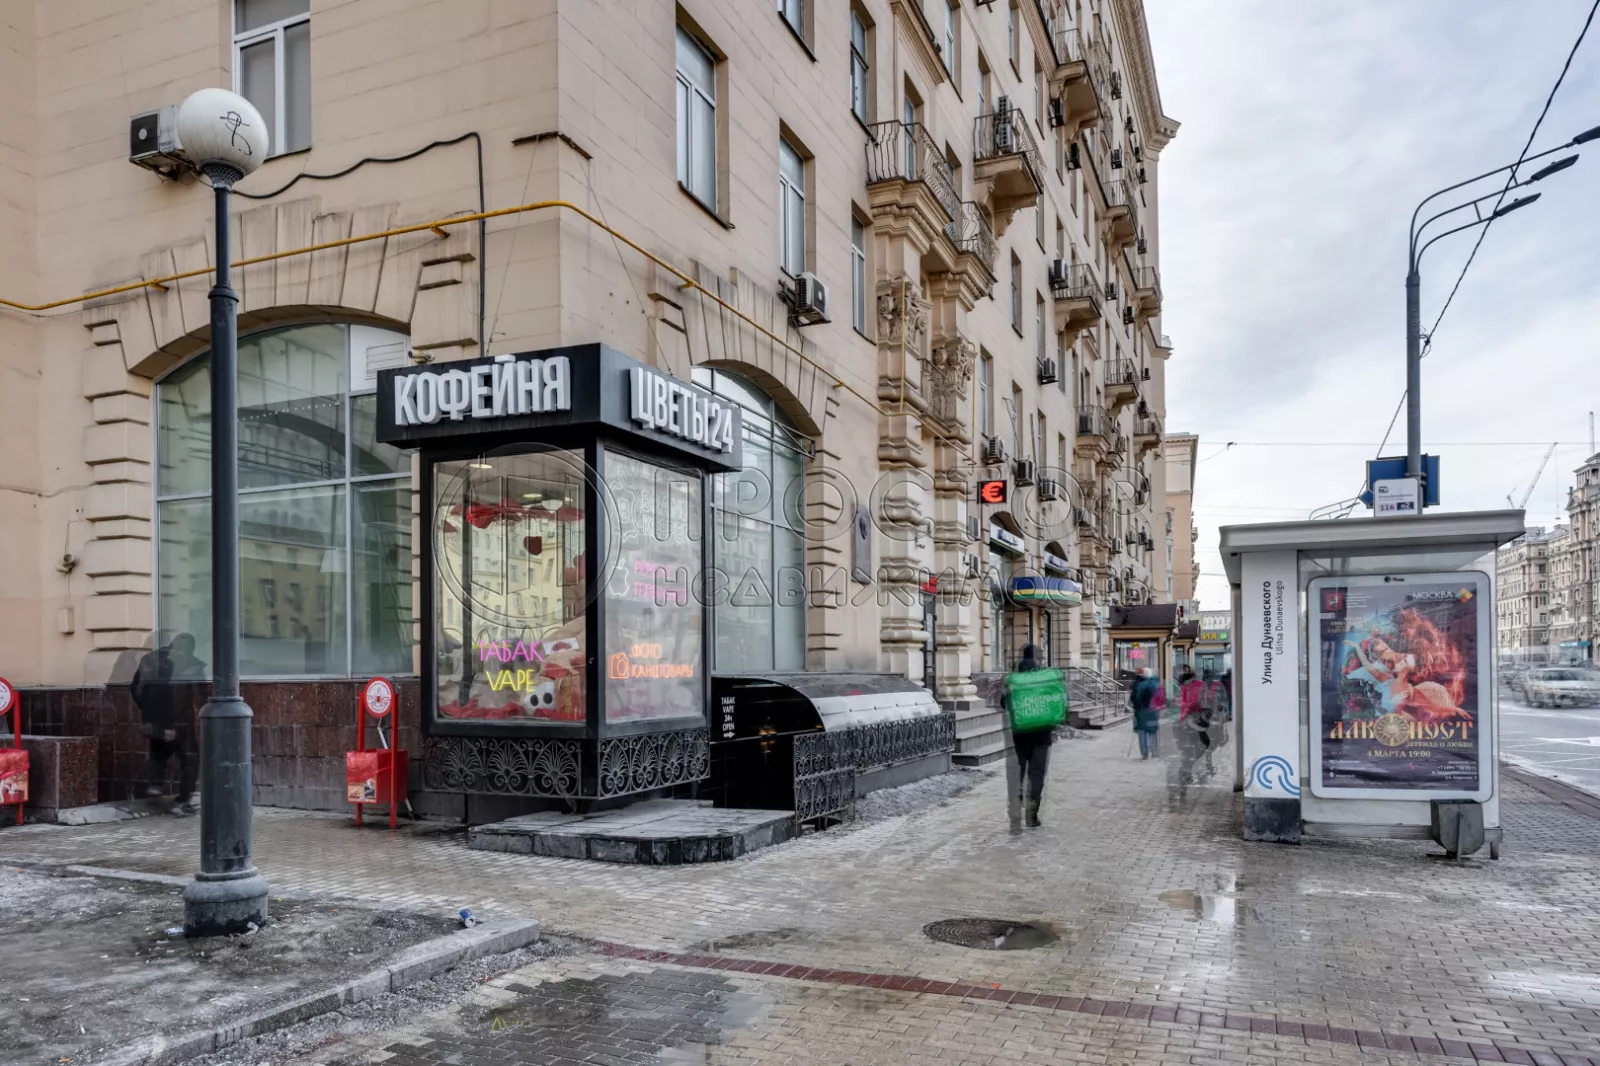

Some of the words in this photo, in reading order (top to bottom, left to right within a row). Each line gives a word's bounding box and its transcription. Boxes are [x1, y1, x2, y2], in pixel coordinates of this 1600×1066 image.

[394, 354, 571, 427] КОФЕЙНЯ
[1275, 580, 1285, 631] Dunaevskogo
[1412, 590, 1453, 600] МОСКВА
[1261, 580, 1274, 650] Дунаевского
[479, 639, 544, 663] ТАБАК
[631, 643, 663, 659] ФОТО
[1275, 632, 1284, 655] Ulitsa
[1262, 651, 1273, 685] Улица
[485, 669, 536, 693] VAPE
[721, 696, 736, 705] ТАБАК
[722, 705, 735, 713] VAPE
[722, 722, 735, 731] OPEN
[1366, 750, 1372, 758] 4
[1374, 750, 1406, 758] МАРТА
[1408, 750, 1431, 758] 19:00
